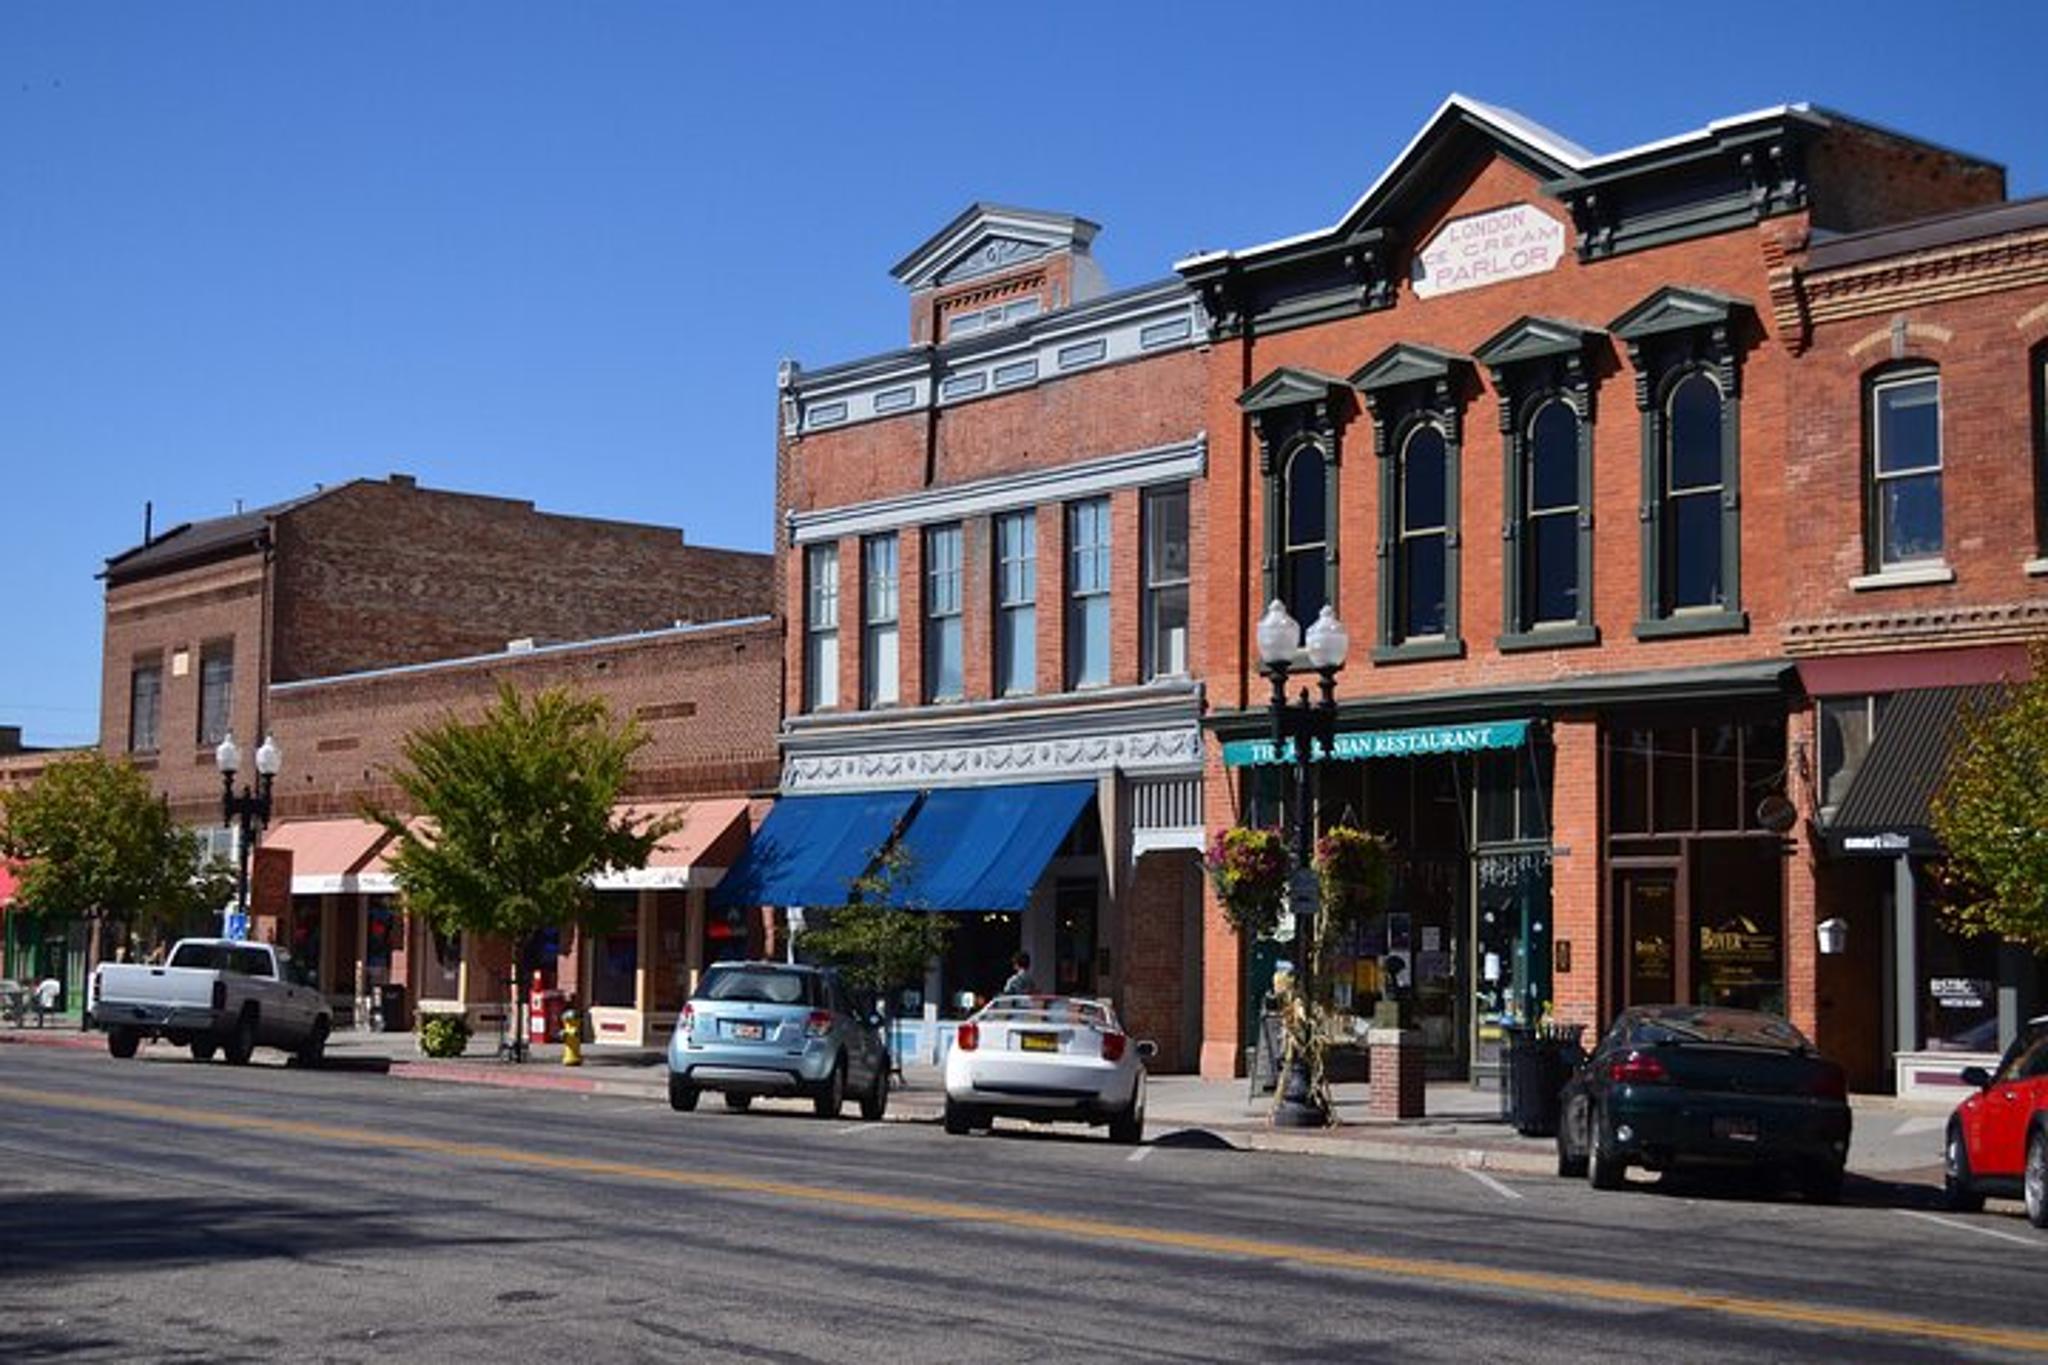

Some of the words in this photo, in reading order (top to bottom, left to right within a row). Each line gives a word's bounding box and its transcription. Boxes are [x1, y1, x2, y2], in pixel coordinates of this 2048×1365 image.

[1450, 211, 1527, 243] LONDON
[1462, 226, 1559, 257] CREAM
[1436, 246, 1548, 287] PARLOR
[1375, 727, 1491, 752] RESTAURANT
